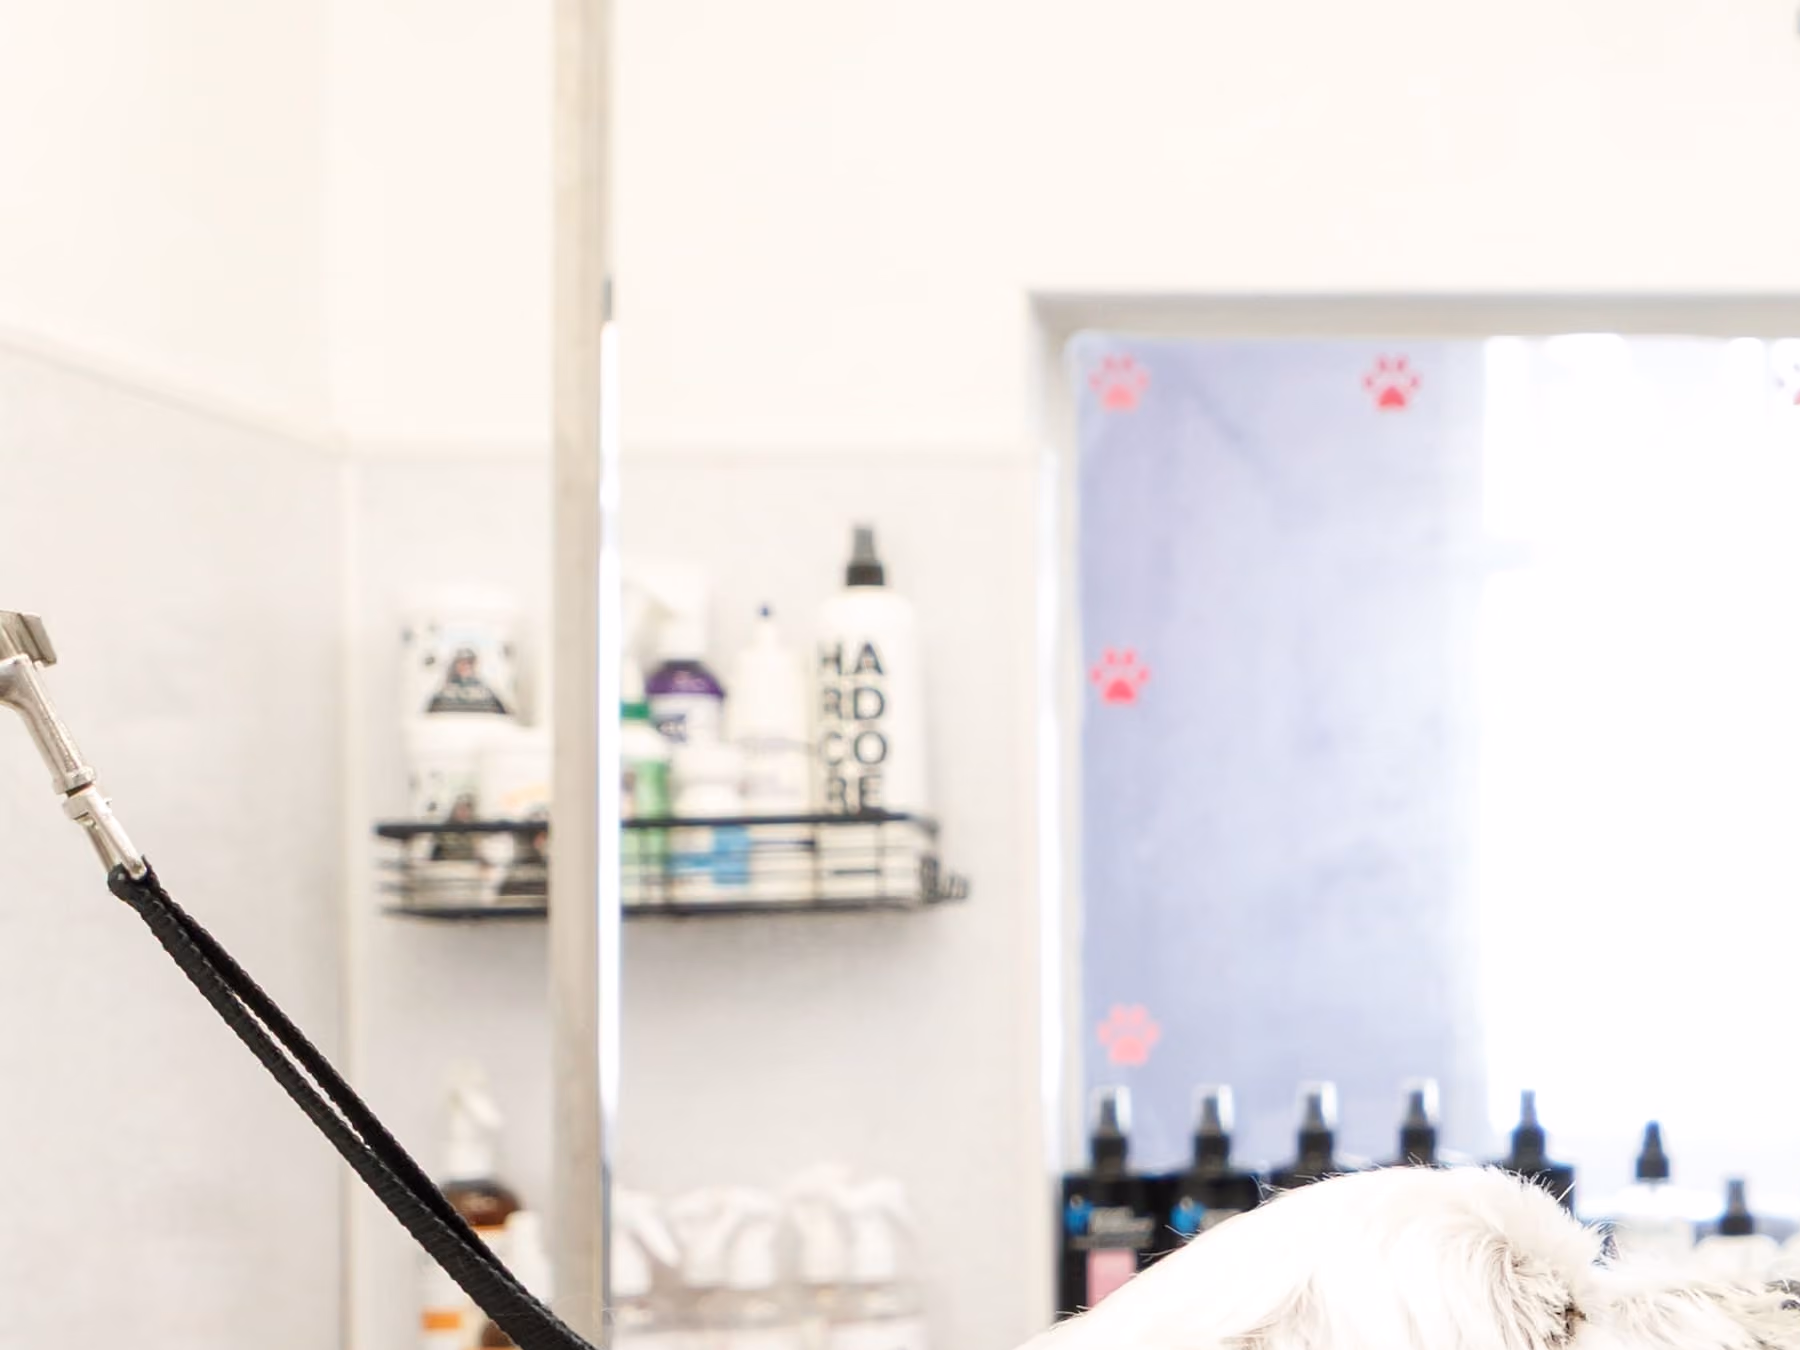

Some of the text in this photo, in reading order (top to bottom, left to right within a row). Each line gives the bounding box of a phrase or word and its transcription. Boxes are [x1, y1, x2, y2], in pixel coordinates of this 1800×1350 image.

[820, 641, 885, 676] HA
[821, 687, 886, 720] RD
[820, 730, 888, 765] CO
[826, 775, 884, 813] RE
